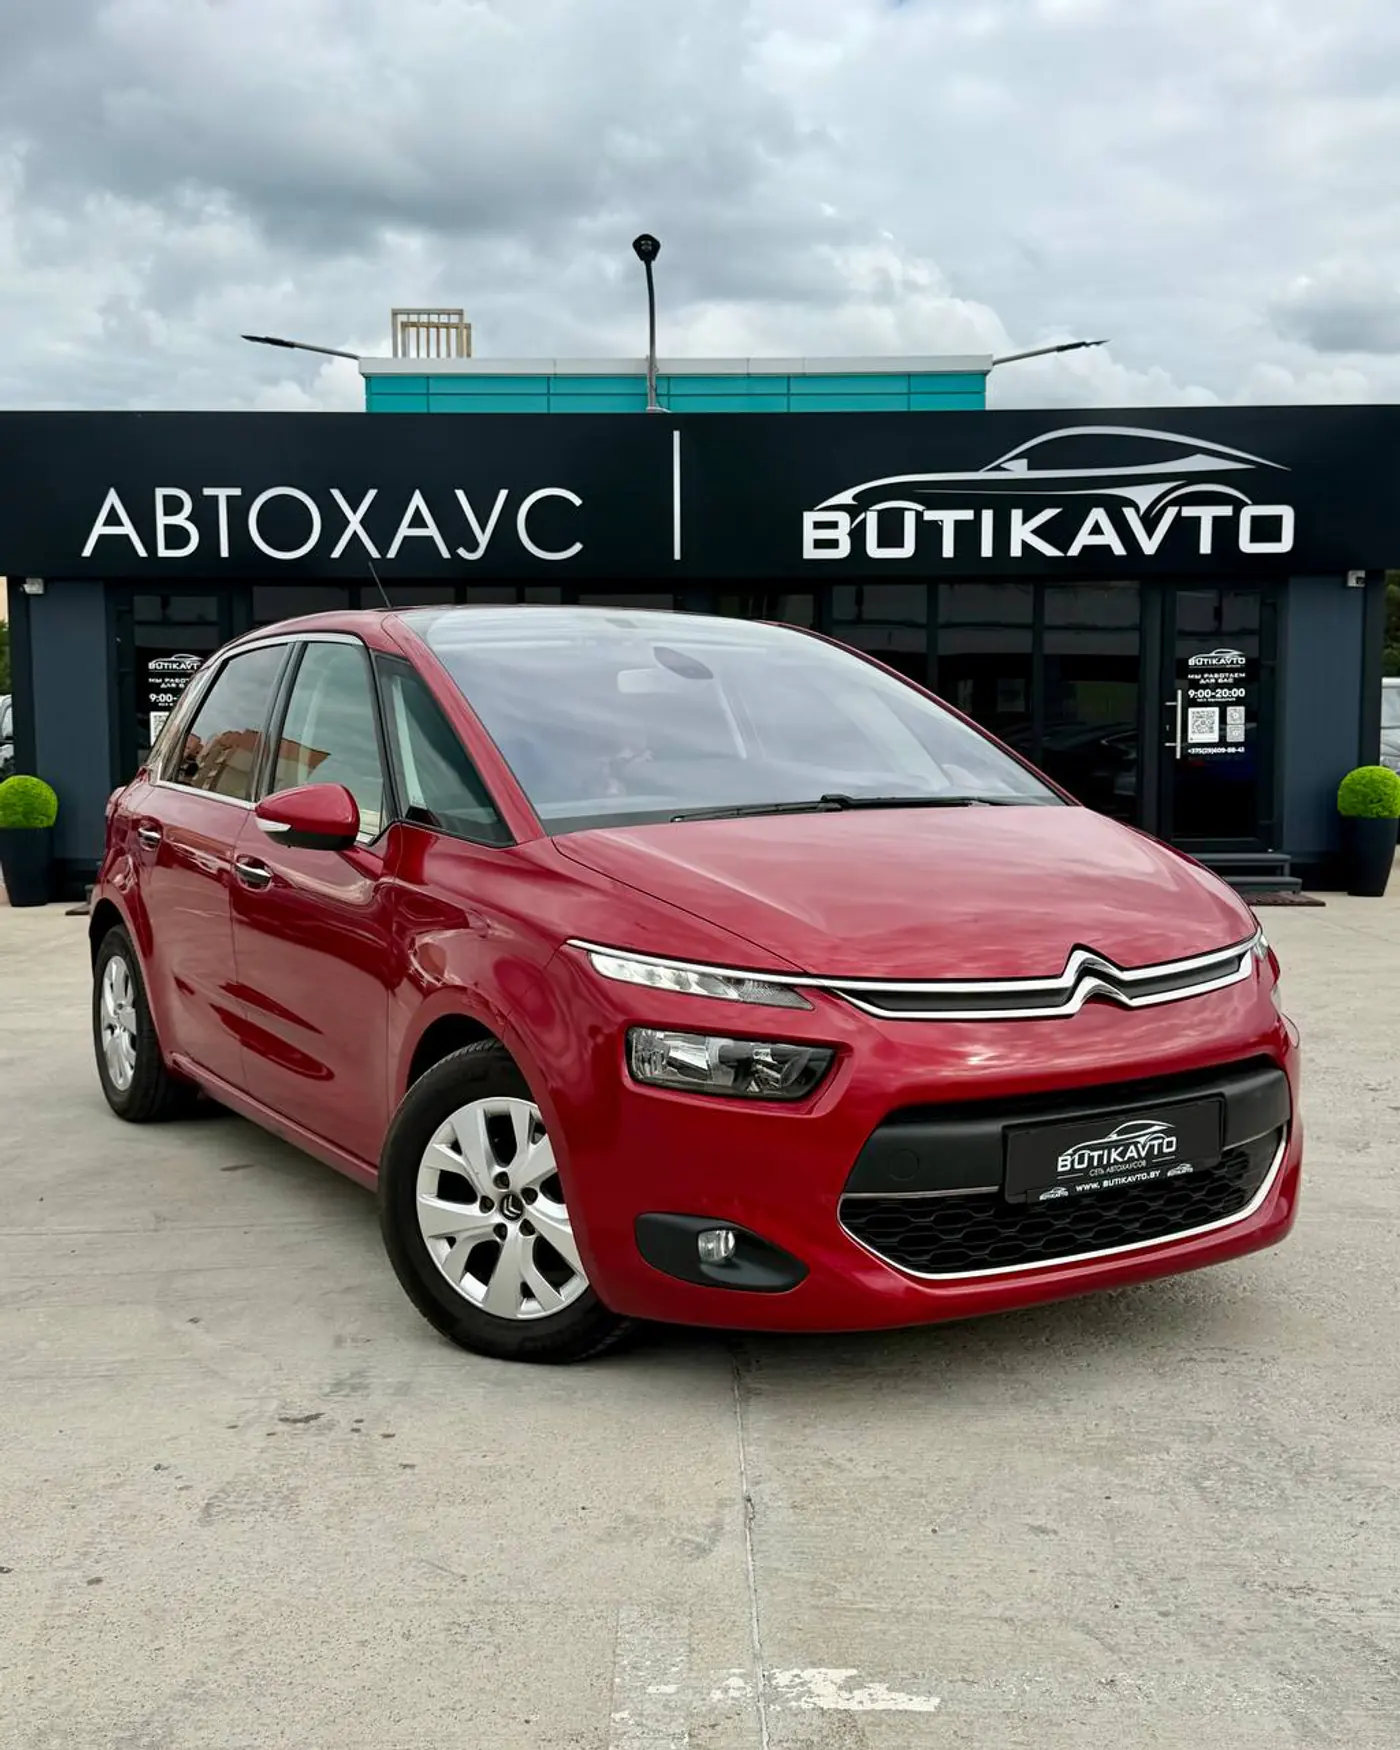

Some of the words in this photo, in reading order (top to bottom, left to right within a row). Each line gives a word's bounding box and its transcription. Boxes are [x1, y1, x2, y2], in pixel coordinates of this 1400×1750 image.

[81, 486, 584, 560] АВТОХАУС
[803, 504, 1295, 560] BUTIKAVTO
[1188, 657, 1246, 665] BUTIKAVTO
[149, 693, 178, 702] 9:00-
[1188, 688, 1246, 698] 9:00-20:00
[1057, 1136, 1177, 1172] BUTIKAVTO
[1103, 1170, 1161, 1188] BUTIKAVTO.BY
